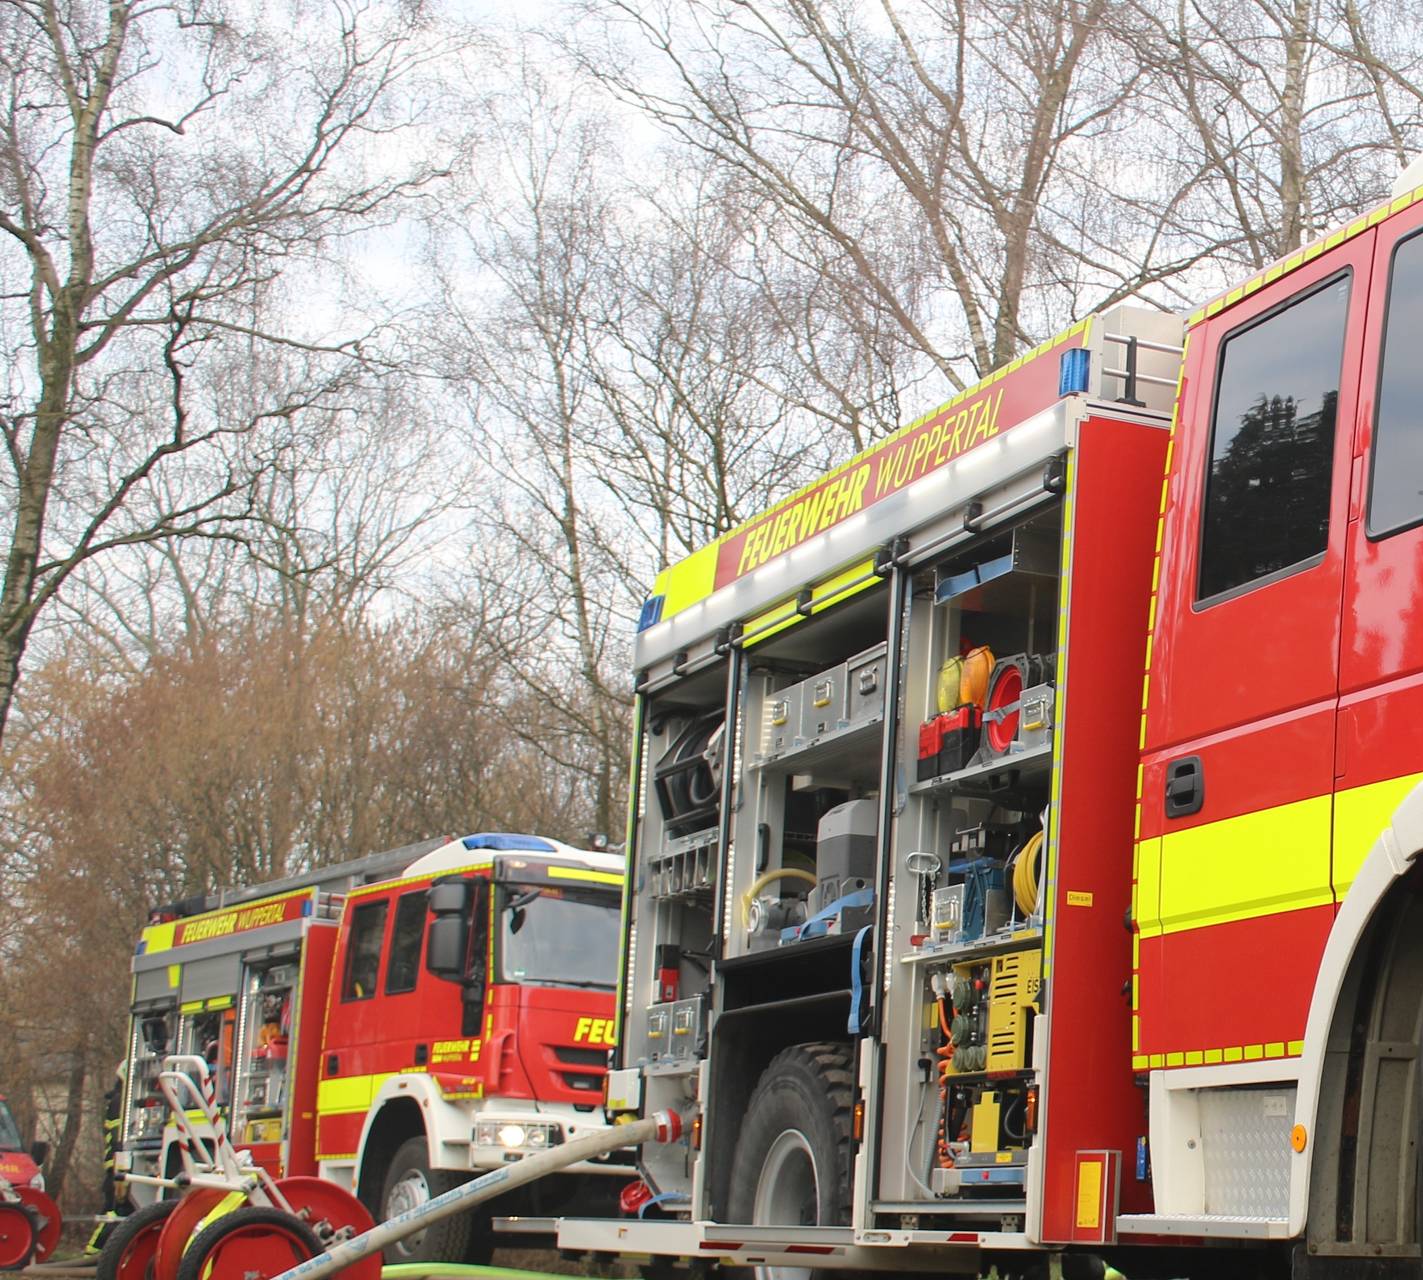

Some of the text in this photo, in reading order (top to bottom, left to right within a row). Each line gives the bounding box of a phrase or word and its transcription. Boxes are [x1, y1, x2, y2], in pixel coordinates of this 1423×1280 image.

[737, 388, 1004, 577] FEUERWEHR WUPPERTAL
[181, 913, 238, 944] FEUERWEHR
